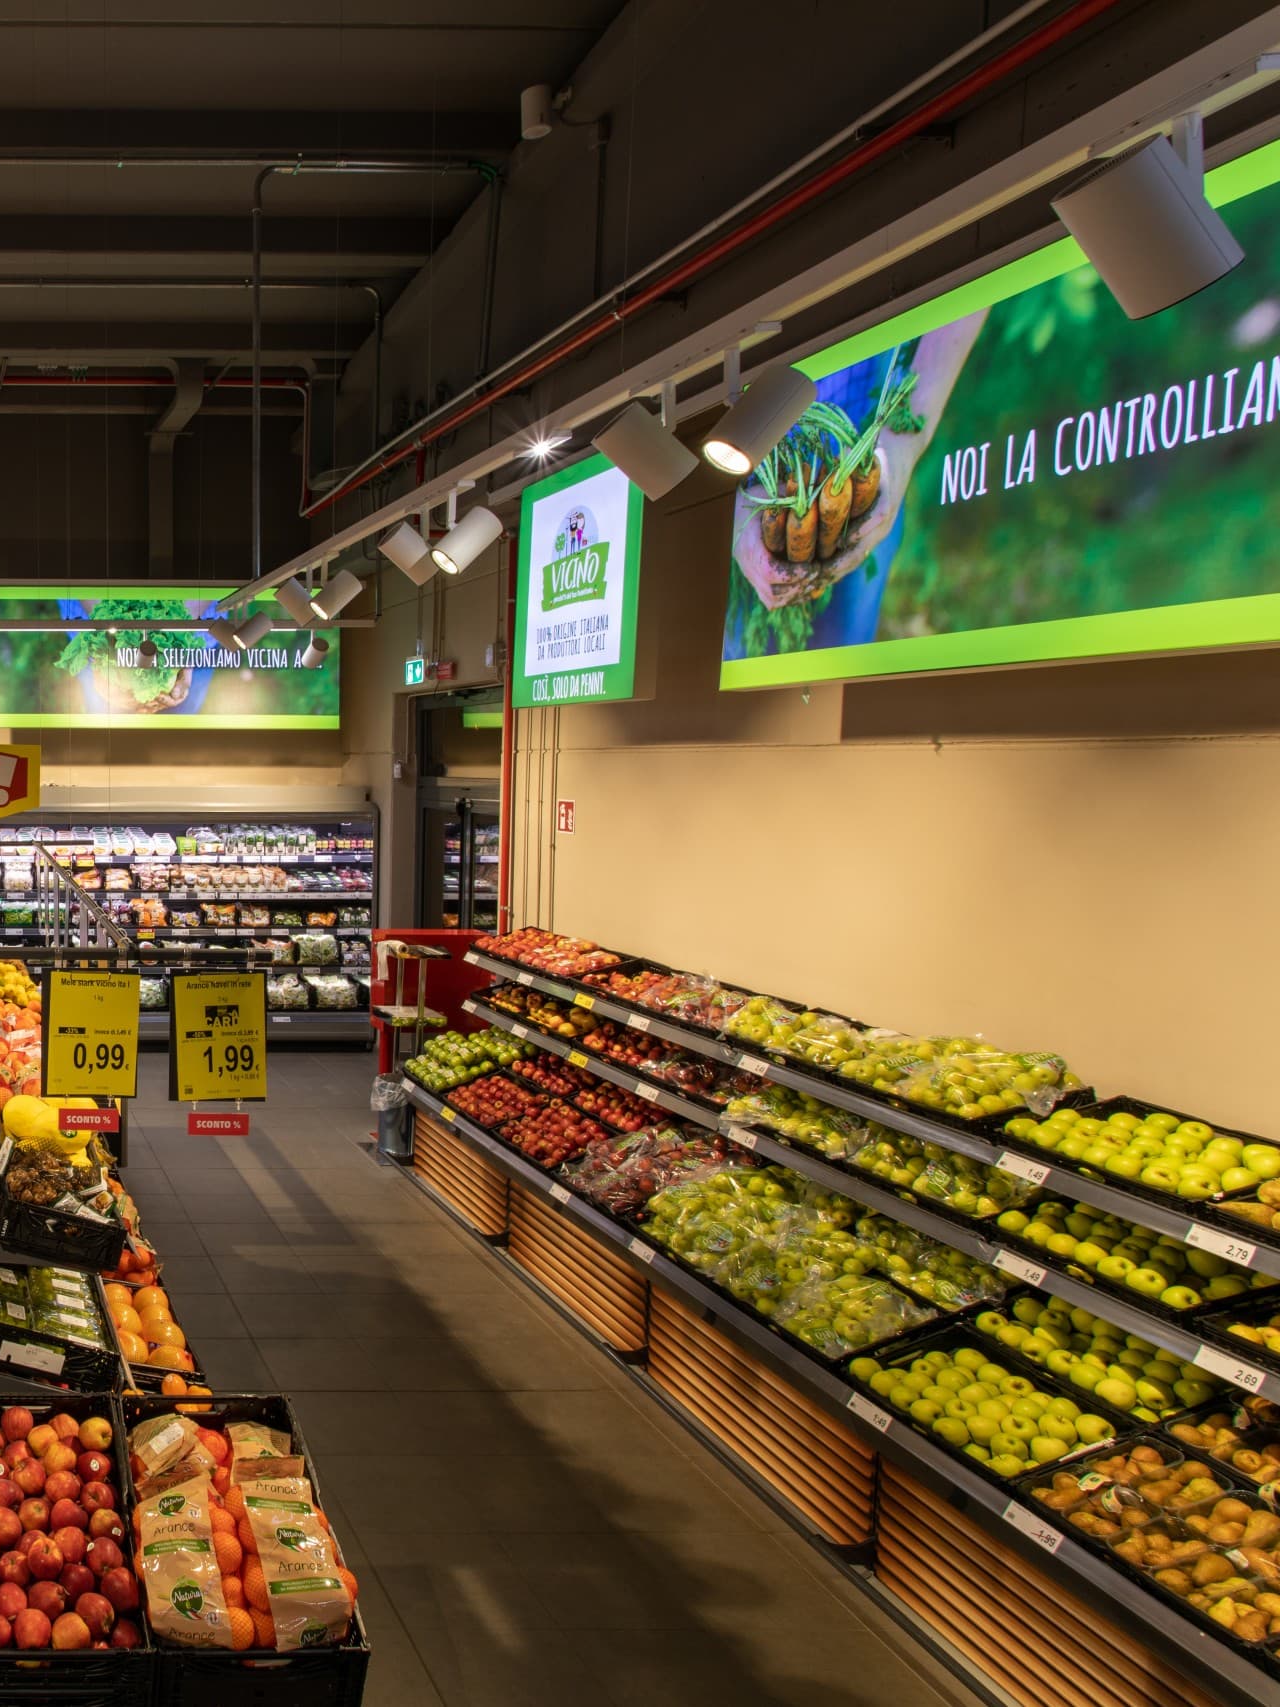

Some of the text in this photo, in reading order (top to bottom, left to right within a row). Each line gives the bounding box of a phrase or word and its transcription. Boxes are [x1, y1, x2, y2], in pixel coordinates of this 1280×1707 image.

[939, 441, 991, 506] NOI
[1004, 428, 1037, 490] LA
[551, 548, 600, 594] VICINO
[536, 614, 609, 645] 100% ORIGINE ITALIANA
[537, 633, 606, 661] DA PRODUTTORI LOCALI
[163, 649, 241, 669] SELEZIONIAMO
[247, 649, 288, 669] VICINA
[532, 671, 606, 702] COSÌ, SOLO DA PENNY.
[73, 1042, 125, 1074] 0,99
[203, 1044, 254, 1078] 1,99
[66, 1115, 101, 1125] SCONTO
[196, 1119, 231, 1130] SCONTO
[1027, 1167, 1045, 1181] 1.49
[1224, 1243, 1250, 1261] 2.79
[1023, 1268, 1041, 1284] 1.49
[1233, 1369, 1259, 1388] 2.69
[255, 1481, 298, 1496] Arance
[153, 1521, 197, 1537] Arance
[278, 1559, 324, 1574] Arance
[168, 1627, 216, 1642] Arance
